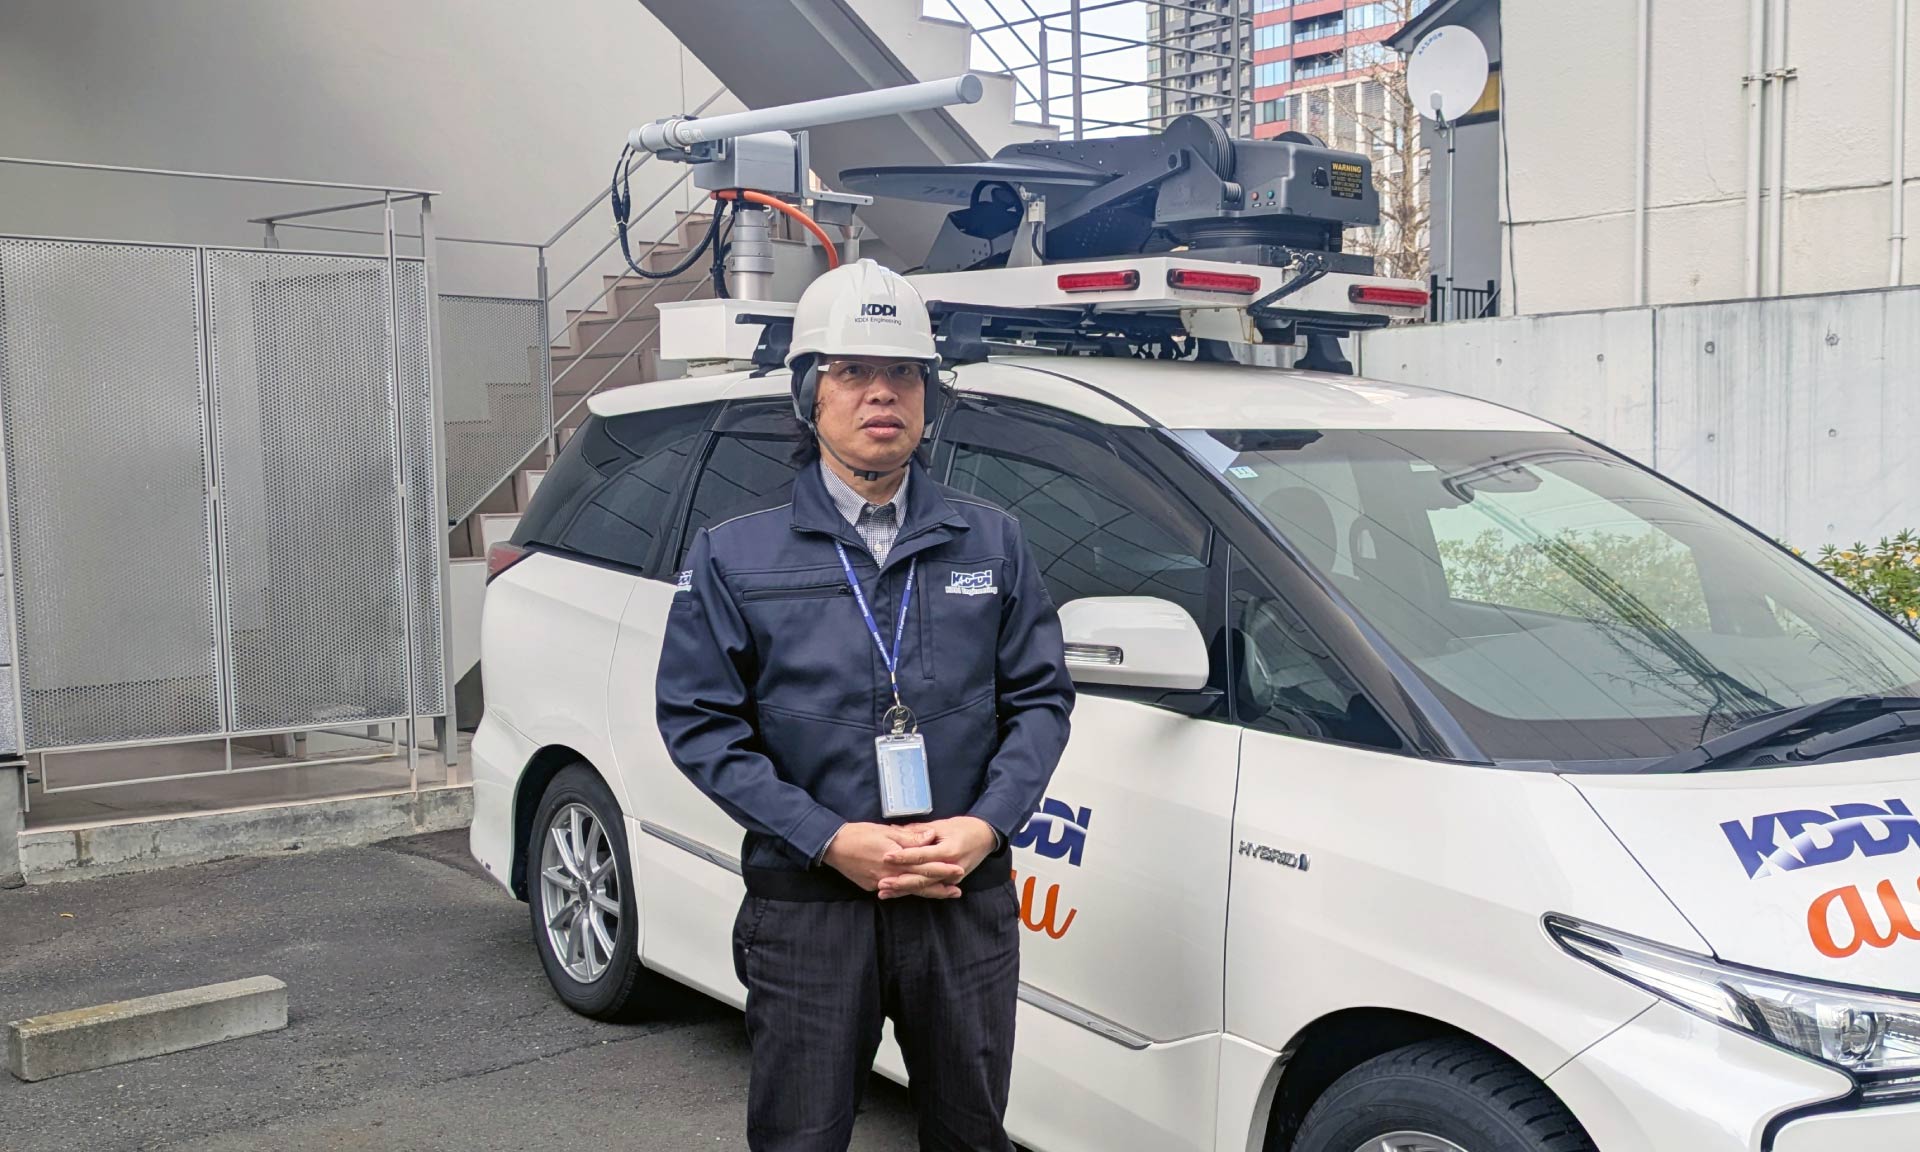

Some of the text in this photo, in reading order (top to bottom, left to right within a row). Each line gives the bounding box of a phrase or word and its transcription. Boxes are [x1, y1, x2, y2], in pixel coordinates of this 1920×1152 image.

[1332, 162, 1362, 173] WARNING
[861, 303, 896, 317] KDDI
[870, 317, 902, 326] Engineering
[951, 569, 992, 588] KDDI
[1719, 798, 1920, 880] KDDI
[1238, 840, 1298, 868] HYBRID
[1011, 868, 1077, 940] u
